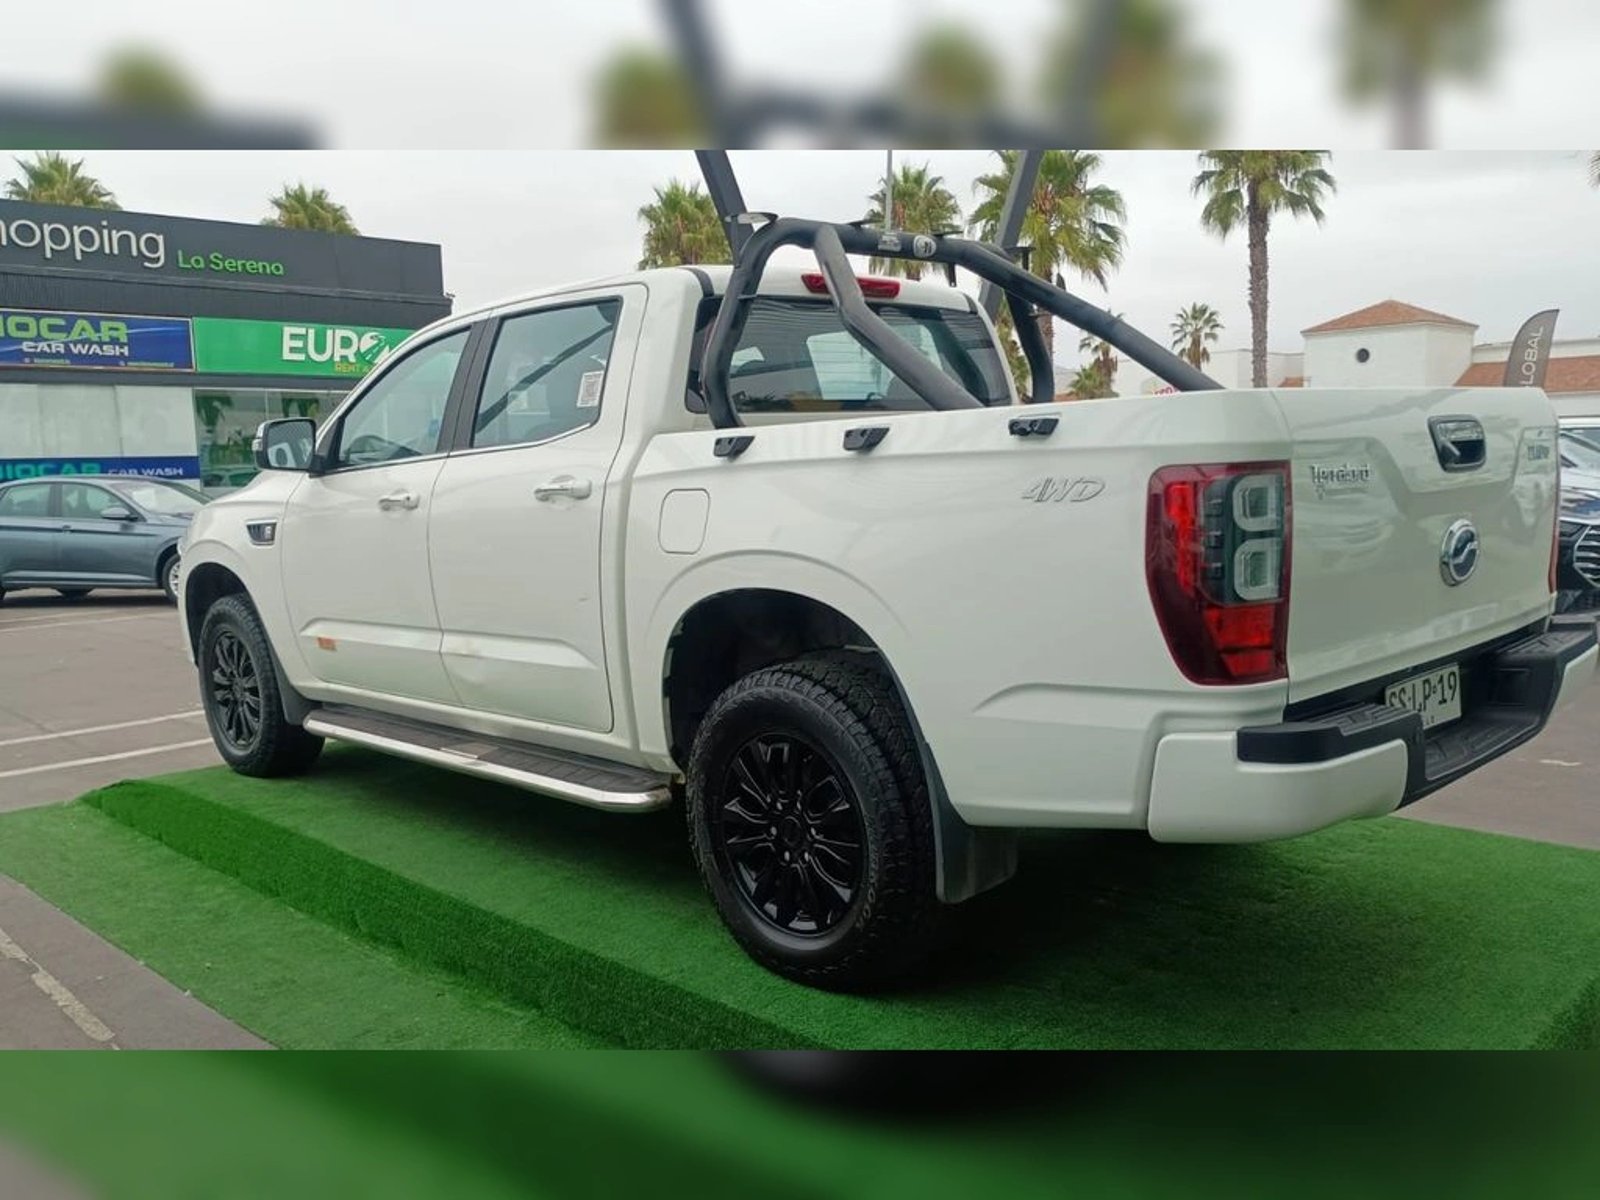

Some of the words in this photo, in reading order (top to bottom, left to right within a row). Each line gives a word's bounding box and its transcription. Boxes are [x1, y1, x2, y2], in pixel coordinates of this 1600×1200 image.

[0, 219, 165, 268] opping
[178, 249, 203, 269] La
[209, 253, 284, 275] Serena
[22, 341, 65, 354] CAR
[69, 343, 129, 357] WASH
[107, 468, 138, 476] CAR
[143, 466, 184, 476] WASH
[1021, 478, 1106, 502] 4WD
